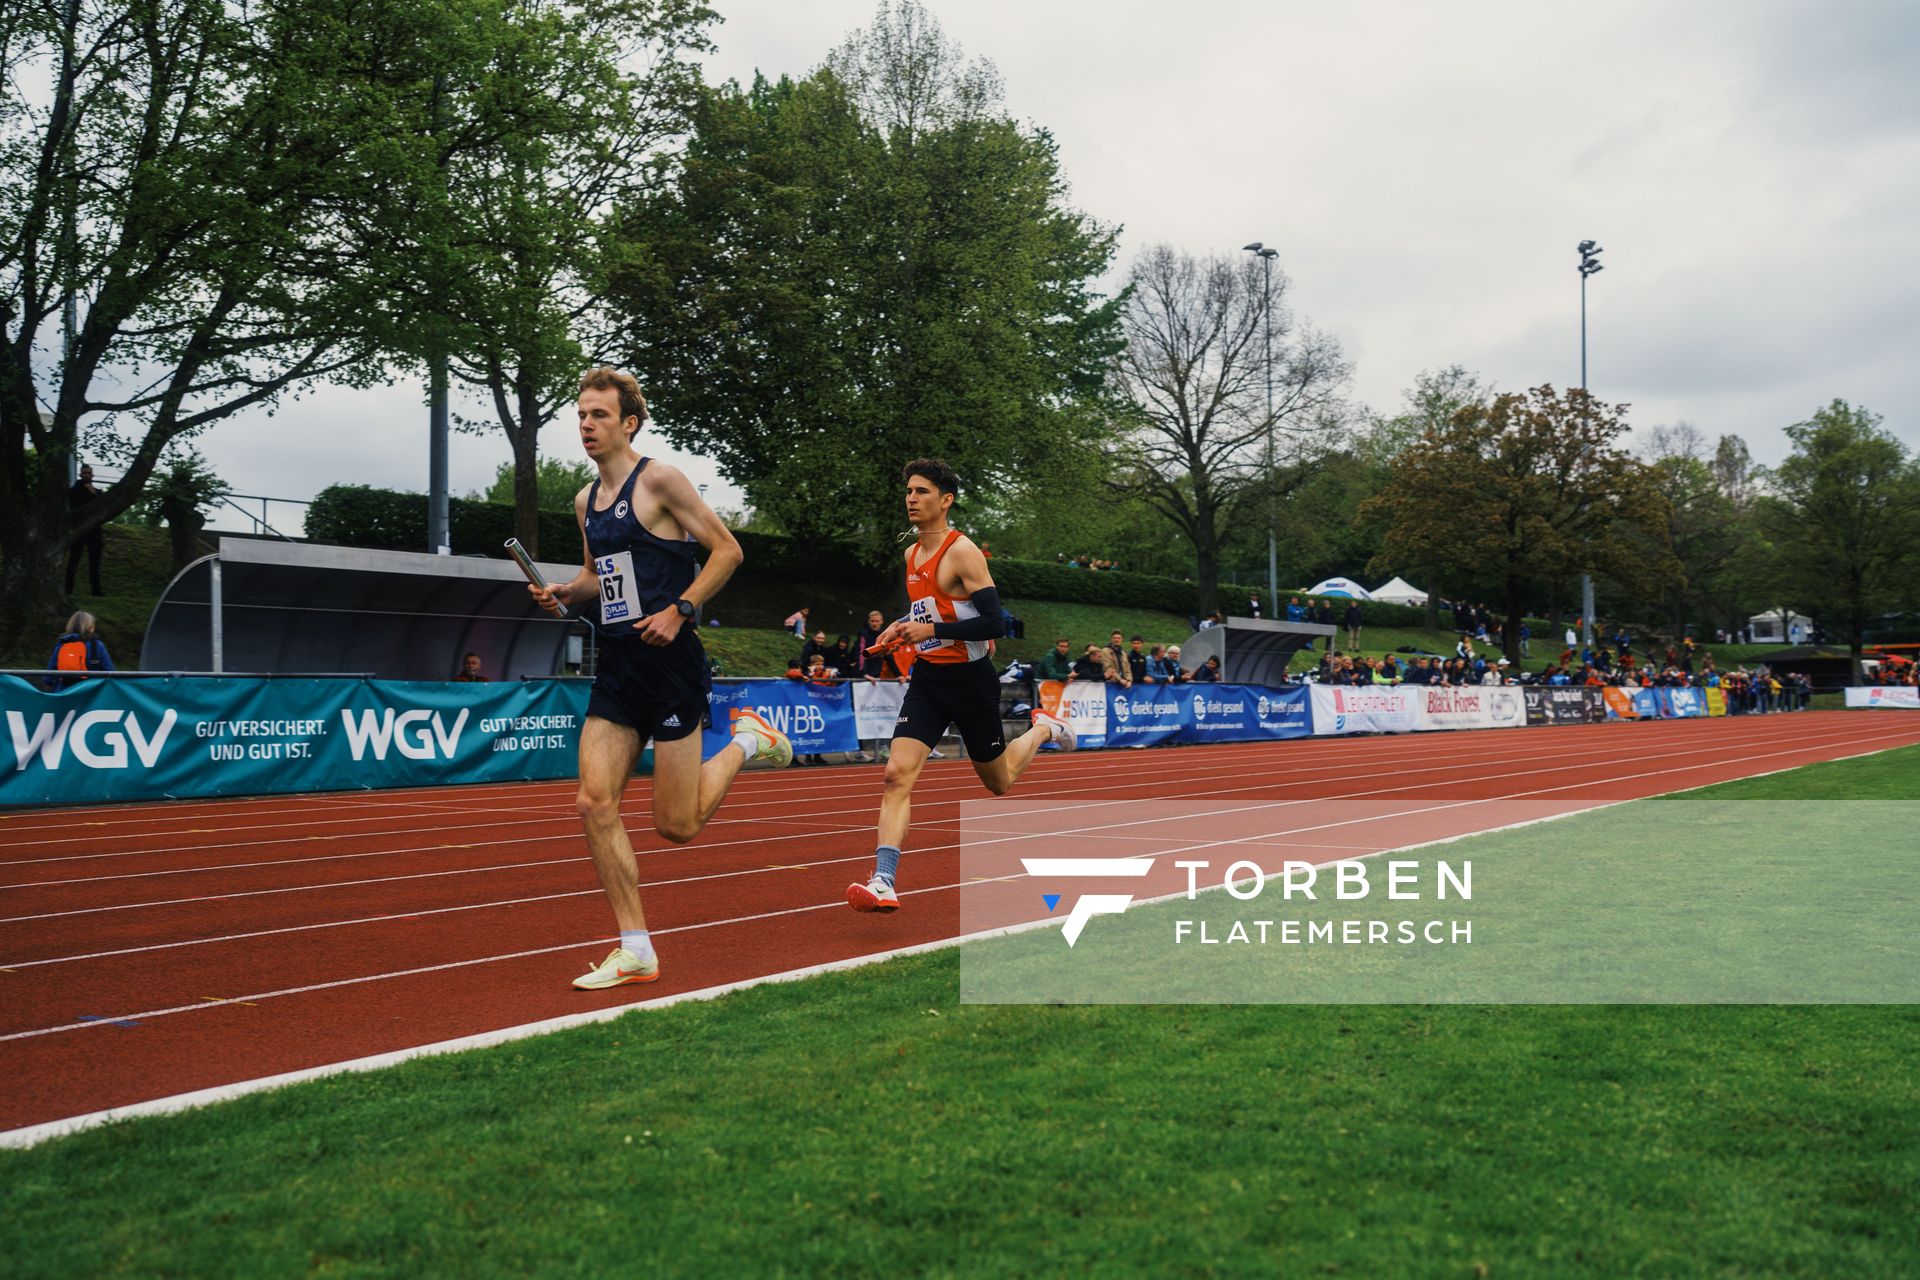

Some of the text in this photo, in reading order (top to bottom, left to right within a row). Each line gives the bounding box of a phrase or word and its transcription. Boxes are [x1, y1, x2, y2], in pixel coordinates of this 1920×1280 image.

[1427, 690, 1481, 713] Black Forest
[195, 719, 327, 738] GUT VERSICHERT.
[341, 707, 470, 760] WGV
[479, 715, 576, 733] GUT VERSICHERT.
[5, 708, 178, 771] WGV
[493, 734, 566, 752] UND GUT IST.
[210, 742, 313, 761] UND GUT IST.
